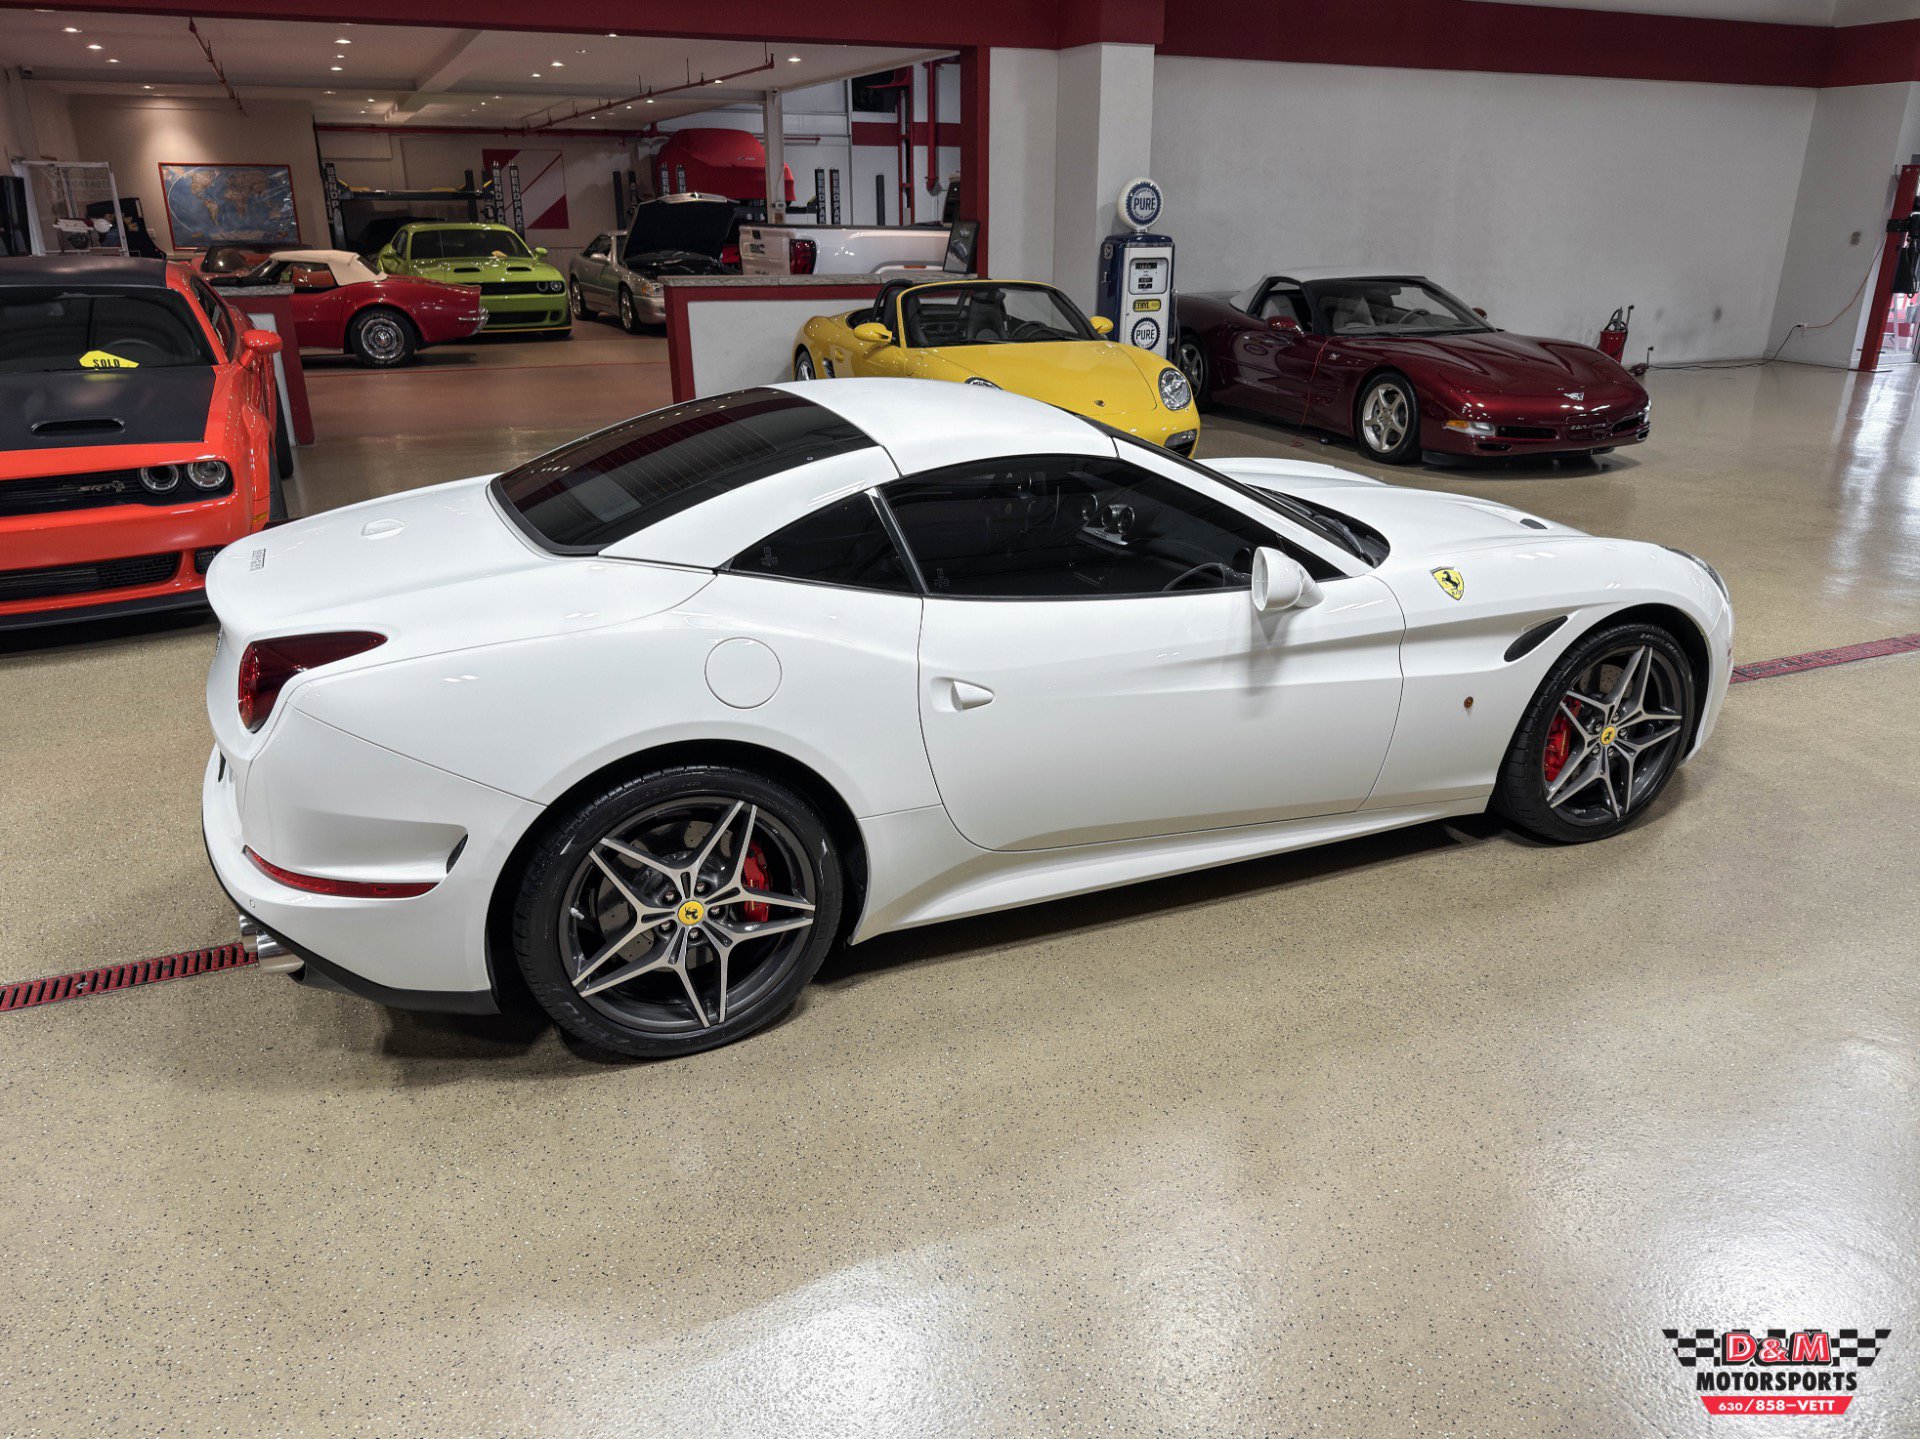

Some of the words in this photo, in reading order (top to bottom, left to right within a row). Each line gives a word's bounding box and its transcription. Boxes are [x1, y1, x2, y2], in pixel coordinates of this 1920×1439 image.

[1133, 197, 1156, 211] PURE
[1136, 329, 1155, 340] PURE
[92, 359, 121, 368] SOLD
